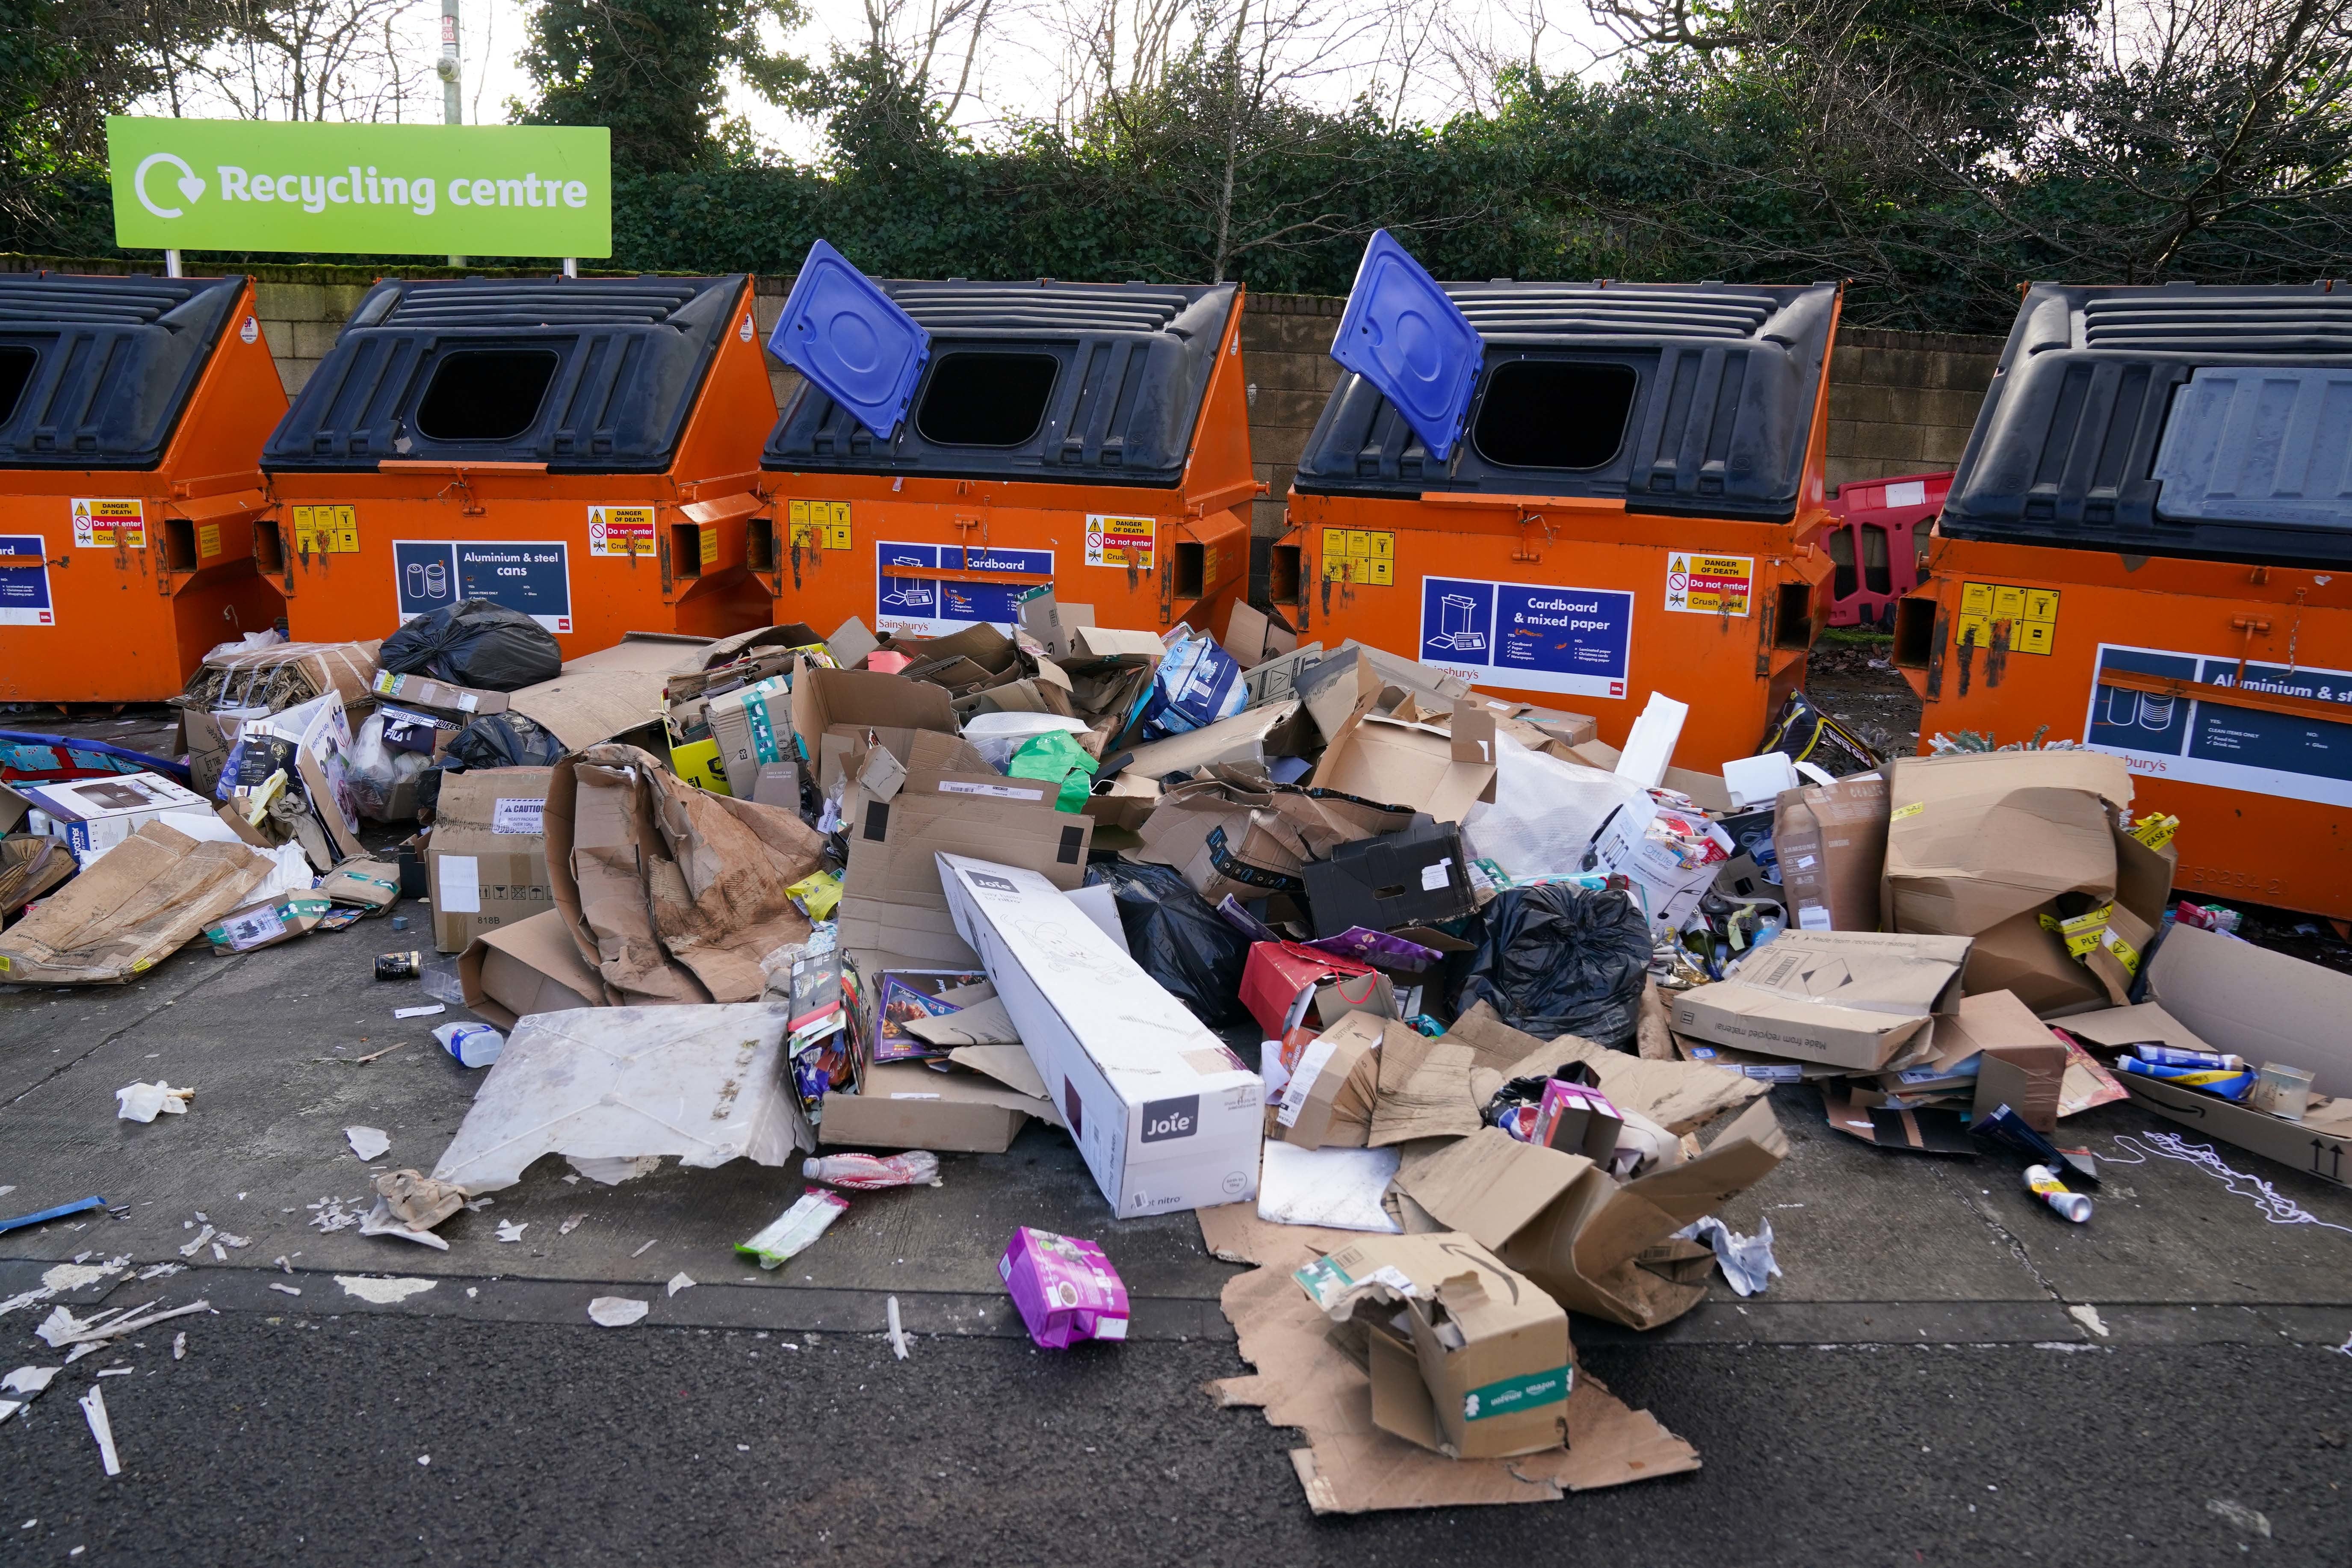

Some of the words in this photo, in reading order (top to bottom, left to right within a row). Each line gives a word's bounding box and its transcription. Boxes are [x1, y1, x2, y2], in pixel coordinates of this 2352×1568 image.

[218, 165, 435, 216] Recycling
[448, 173, 588, 208] centre
[464, 552, 520, 562] Aluminium
[523, 553, 532, 562] &
[534, 552, 558, 562] steel
[967, 558, 1025, 570] Cardboard
[497, 567, 527, 576] cans
[1528, 597, 1598, 613] Cardboard
[1692, 597, 1718, 606] Crush
[879, 619, 928, 632] Sainsbury's
[1514, 612, 1524, 623] &
[1528, 614, 1567, 627] mixed
[1571, 619, 1610, 630] paper
[1204, 661, 1218, 683] CATSAN
[2317, 686, 2332, 700] &
[392, 710, 423, 724] LIFESTYLE
[384, 728, 403, 742] FILA
[1826, 729, 1852, 753] ELITE
[739, 748, 748, 760] E3
[1852, 748, 1872, 768] PRO
[204, 757, 213, 772] LET
[213, 756, 222, 767] THE
[203, 773, 217, 788] FEAST
[72, 827, 81, 856] brother
[1210, 830, 1222, 844] prime
[1828, 839, 1850, 848] SAMSUNG
[1783, 843, 1817, 853] SAMSUNG
[1213, 849, 1225, 865] prime
[1243, 869, 1254, 881] prime
[978, 879, 1012, 890] Joie
[1714, 1022, 1746, 1035] material
[1748, 1029, 1780, 1041] recycled
[1783, 1036, 1802, 1046] from
[1805, 1039, 1827, 1050] Made
[1147, 1112, 1190, 1136] Joie
[1157, 1196, 1180, 1206] nitro
[1491, 1391, 1522, 1406] amazon
